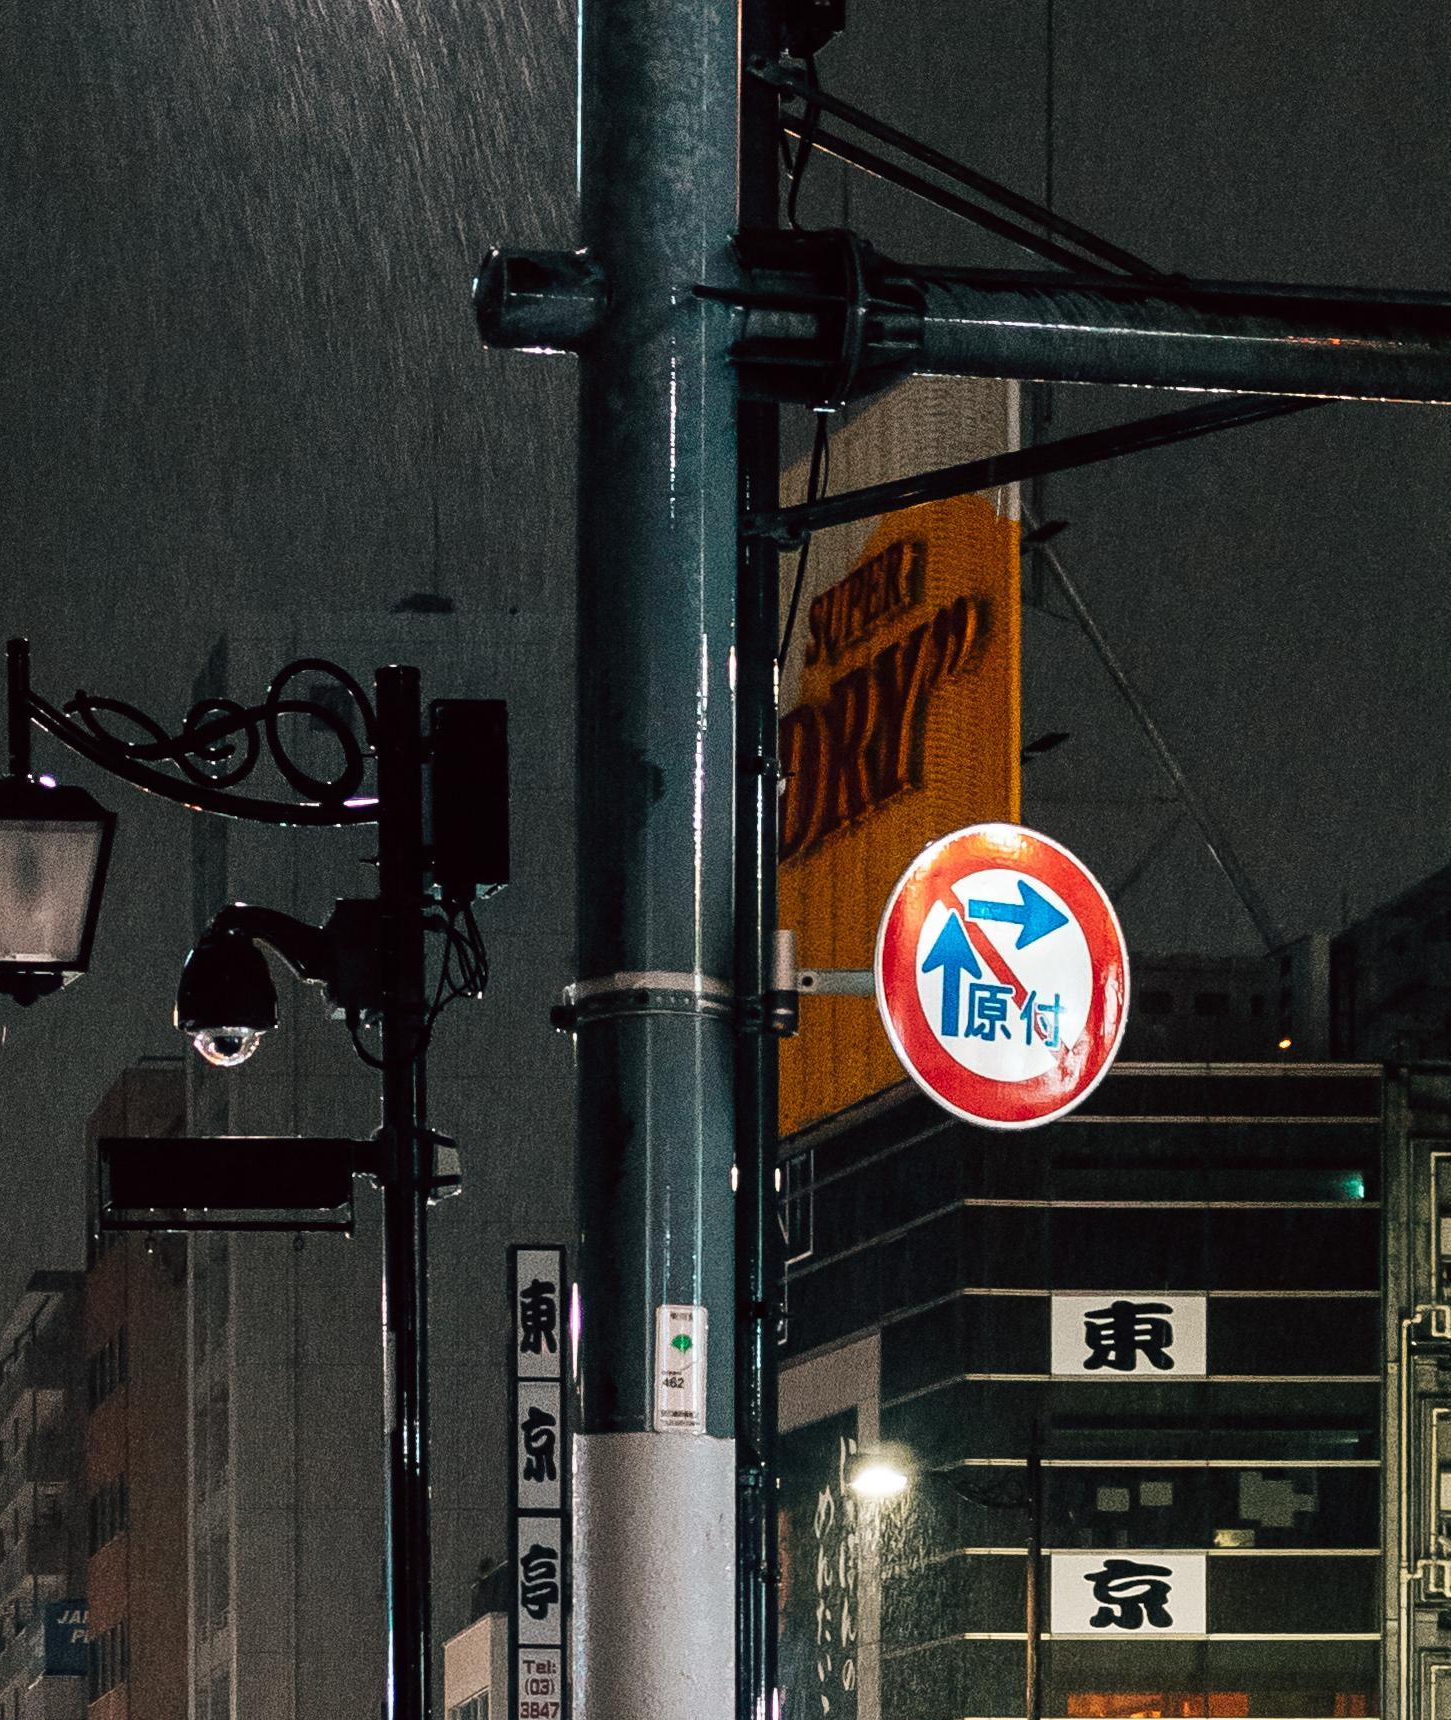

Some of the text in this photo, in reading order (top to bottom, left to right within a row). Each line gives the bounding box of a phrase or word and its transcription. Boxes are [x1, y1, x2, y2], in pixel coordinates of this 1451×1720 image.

[965, 983, 1066, 1047] 原付
[522, 1660, 557, 1675] Tel:
[525, 1679, 556, 1696] (03)
[520, 1701, 560, 1719] 3847
